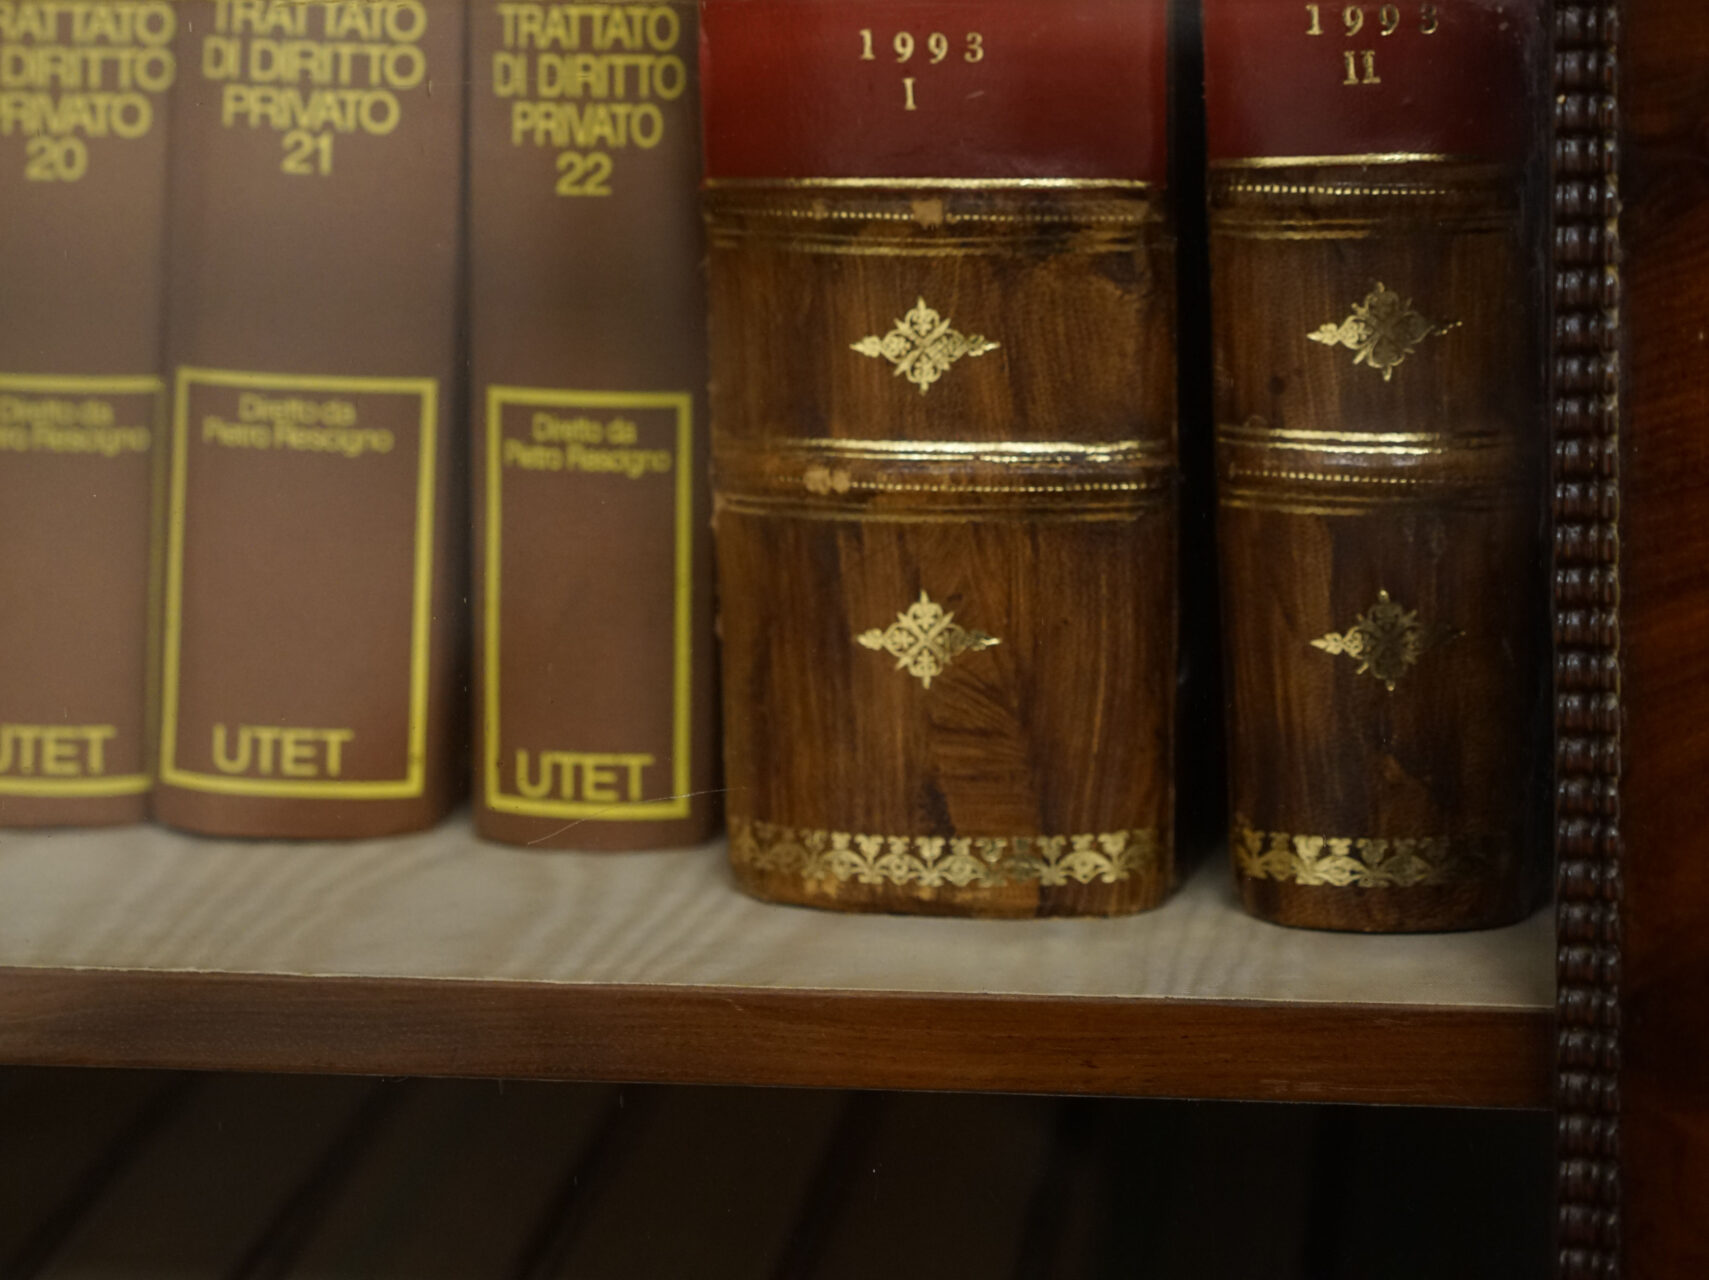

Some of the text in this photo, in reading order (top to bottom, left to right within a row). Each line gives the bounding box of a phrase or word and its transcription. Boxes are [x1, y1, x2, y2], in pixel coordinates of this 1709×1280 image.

[498, 3, 680, 51] TRATTATO
[1305, 4, 1439, 36] 1993
[202, 35, 426, 90] DI DIRITTO
[859, 28, 985, 64] 1993
[493, 51, 686, 100] DI DIRITTO
[902, 77, 917, 111] I
[222, 84, 400, 135] PRIVATO
[512, 101, 664, 149] PRIVATO
[26, 137, 87, 181] 20
[282, 130, 333, 176] 21
[556, 151, 612, 196] 22
[213, 724, 354, 776] UTET
[516, 750, 655, 801] UTET
